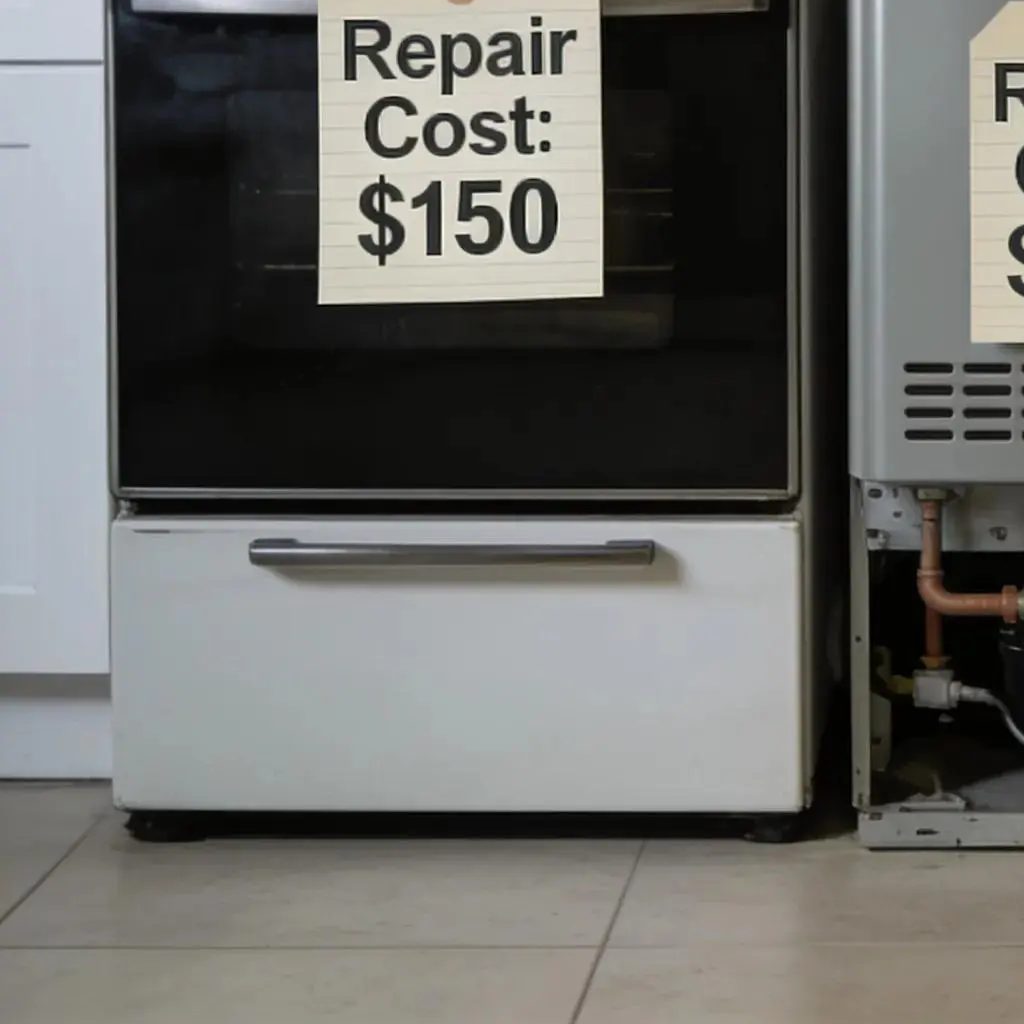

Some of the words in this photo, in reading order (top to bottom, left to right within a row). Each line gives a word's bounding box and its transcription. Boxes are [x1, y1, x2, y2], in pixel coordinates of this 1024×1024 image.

[344, 17, 577, 96] Repair
[365, 95, 551, 158] Cost:
[359, 175, 559, 266] $150
